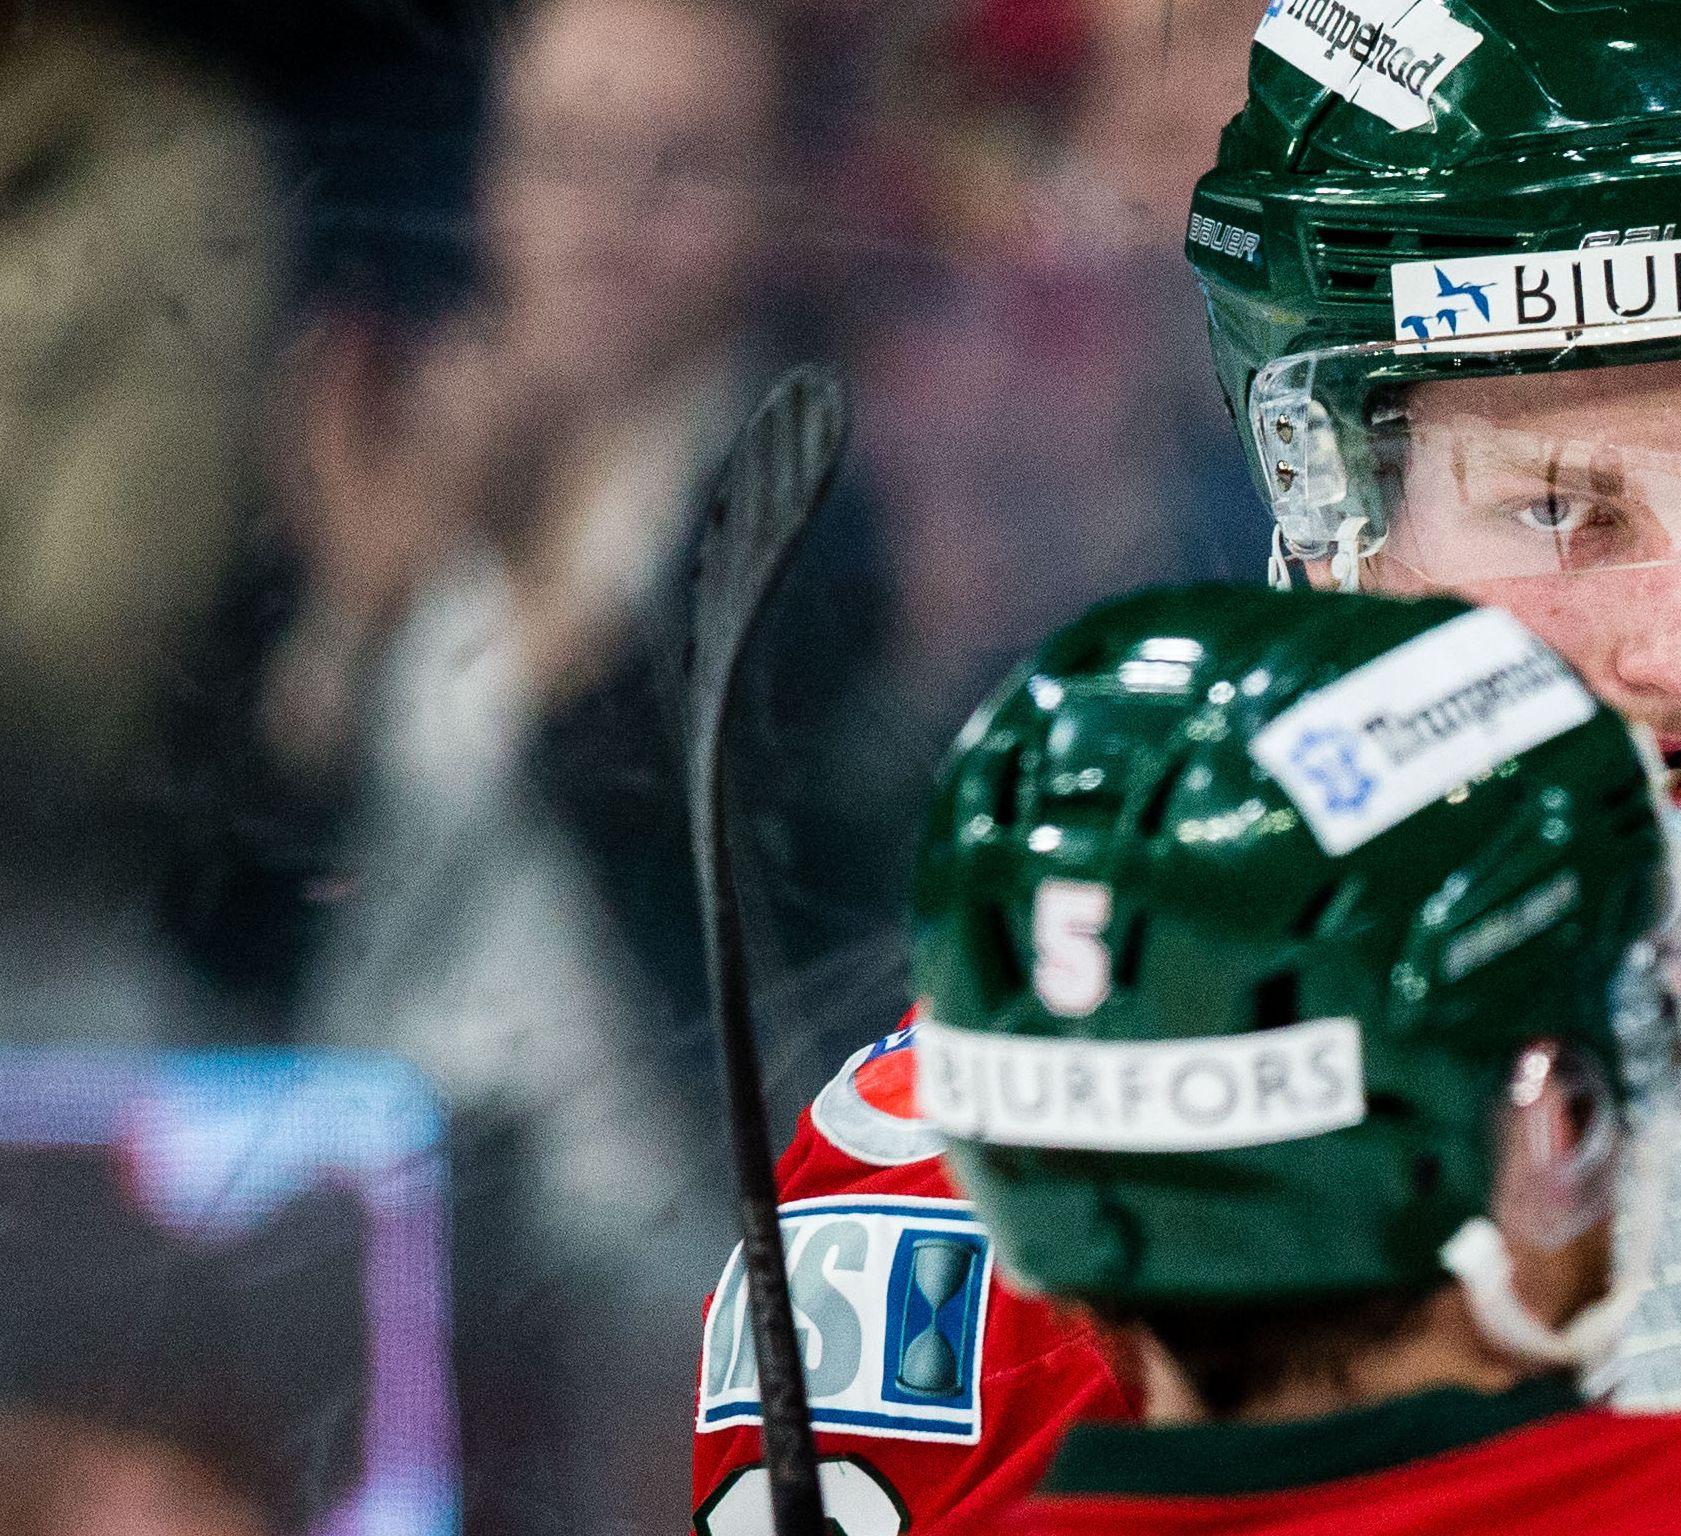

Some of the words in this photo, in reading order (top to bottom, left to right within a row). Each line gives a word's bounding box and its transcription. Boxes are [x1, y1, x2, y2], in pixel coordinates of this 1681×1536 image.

[1286, 0, 1446, 100] anpenad
[1189, 213, 1261, 261] BAUER
[1034, 880, 1112, 1016] 5
